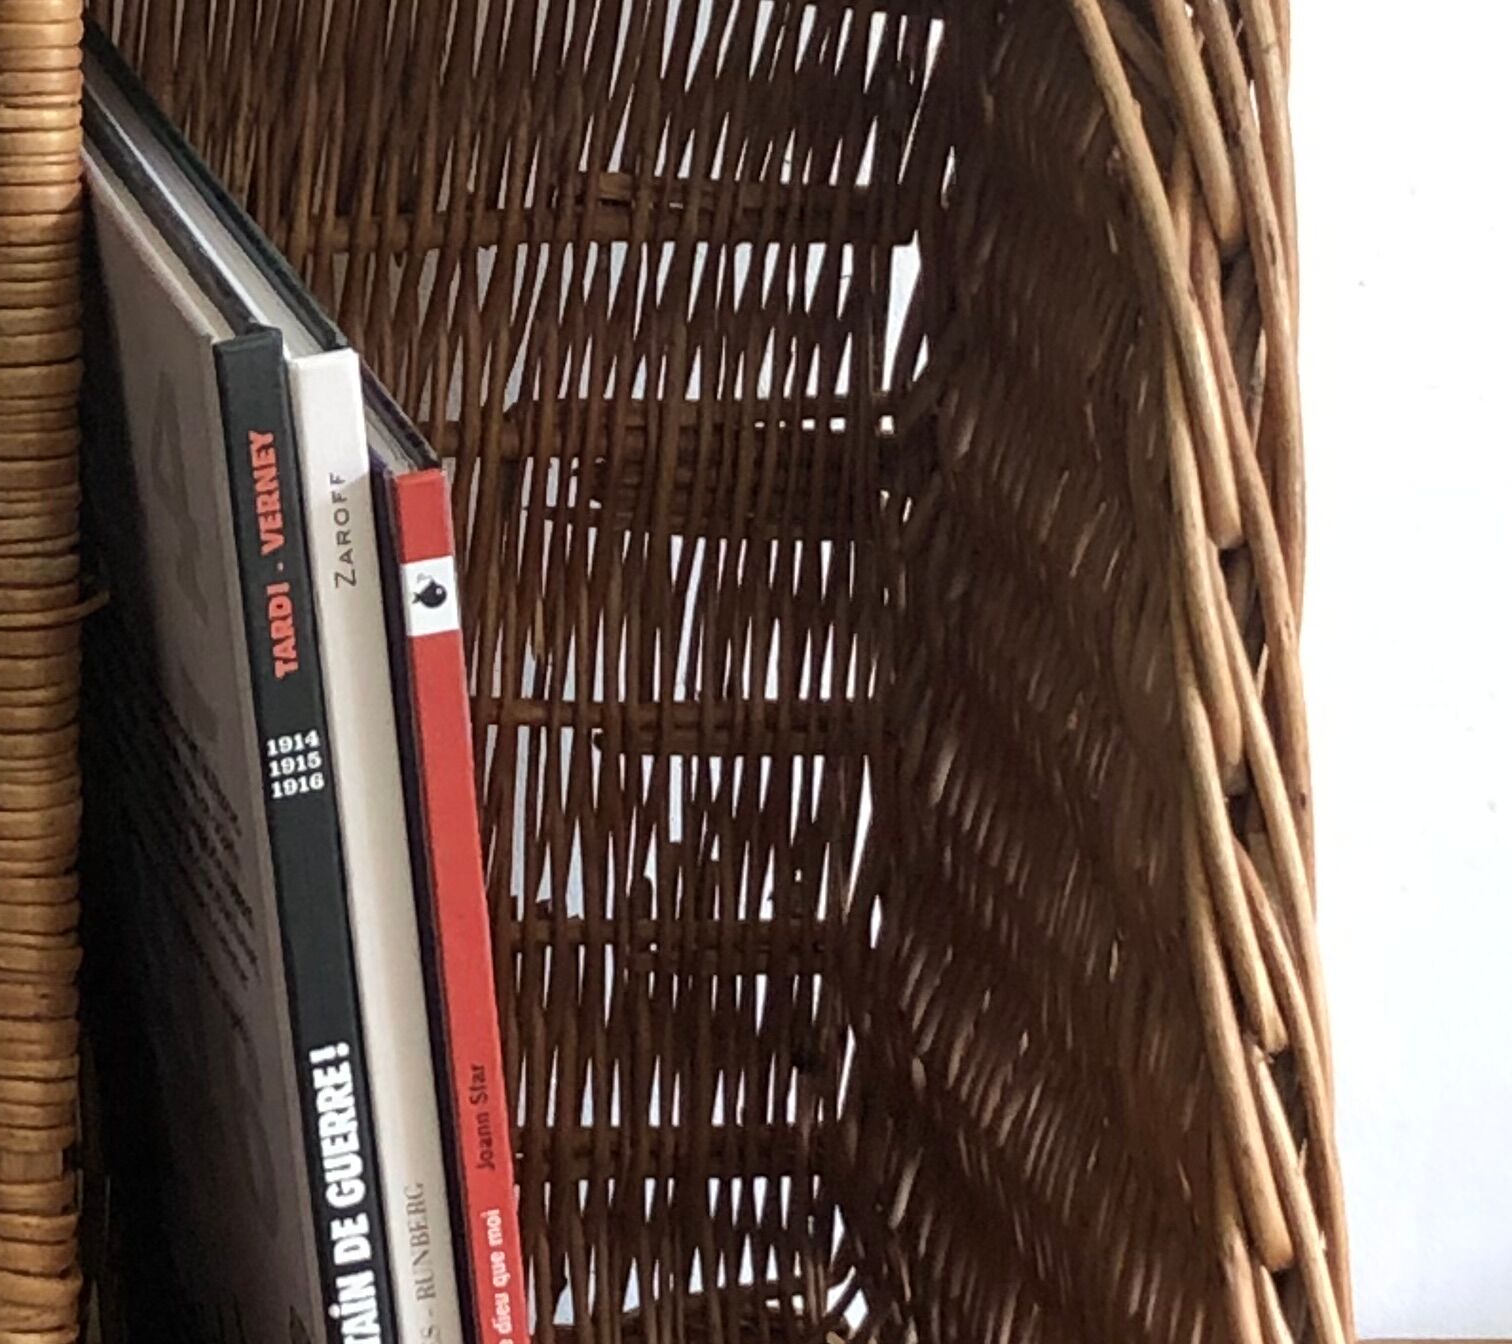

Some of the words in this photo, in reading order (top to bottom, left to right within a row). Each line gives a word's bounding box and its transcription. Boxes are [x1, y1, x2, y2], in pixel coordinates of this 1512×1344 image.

[248, 430, 288, 555] VERNEY
[329, 471, 357, 589] ZAROFF
[267, 581, 299, 680] TARDI
[266, 730, 321, 756] 1914
[268, 752, 323, 778] 1915
[270, 773, 325, 799] 1916
[475, 1112, 496, 1171] Joann
[331, 1212, 370, 1266] DE
[404, 1182, 437, 1300] RUNBERG
[480, 1209, 502, 1247] moi
[490, 1251, 509, 1288] que
[491, 1292, 513, 1334] dieu
